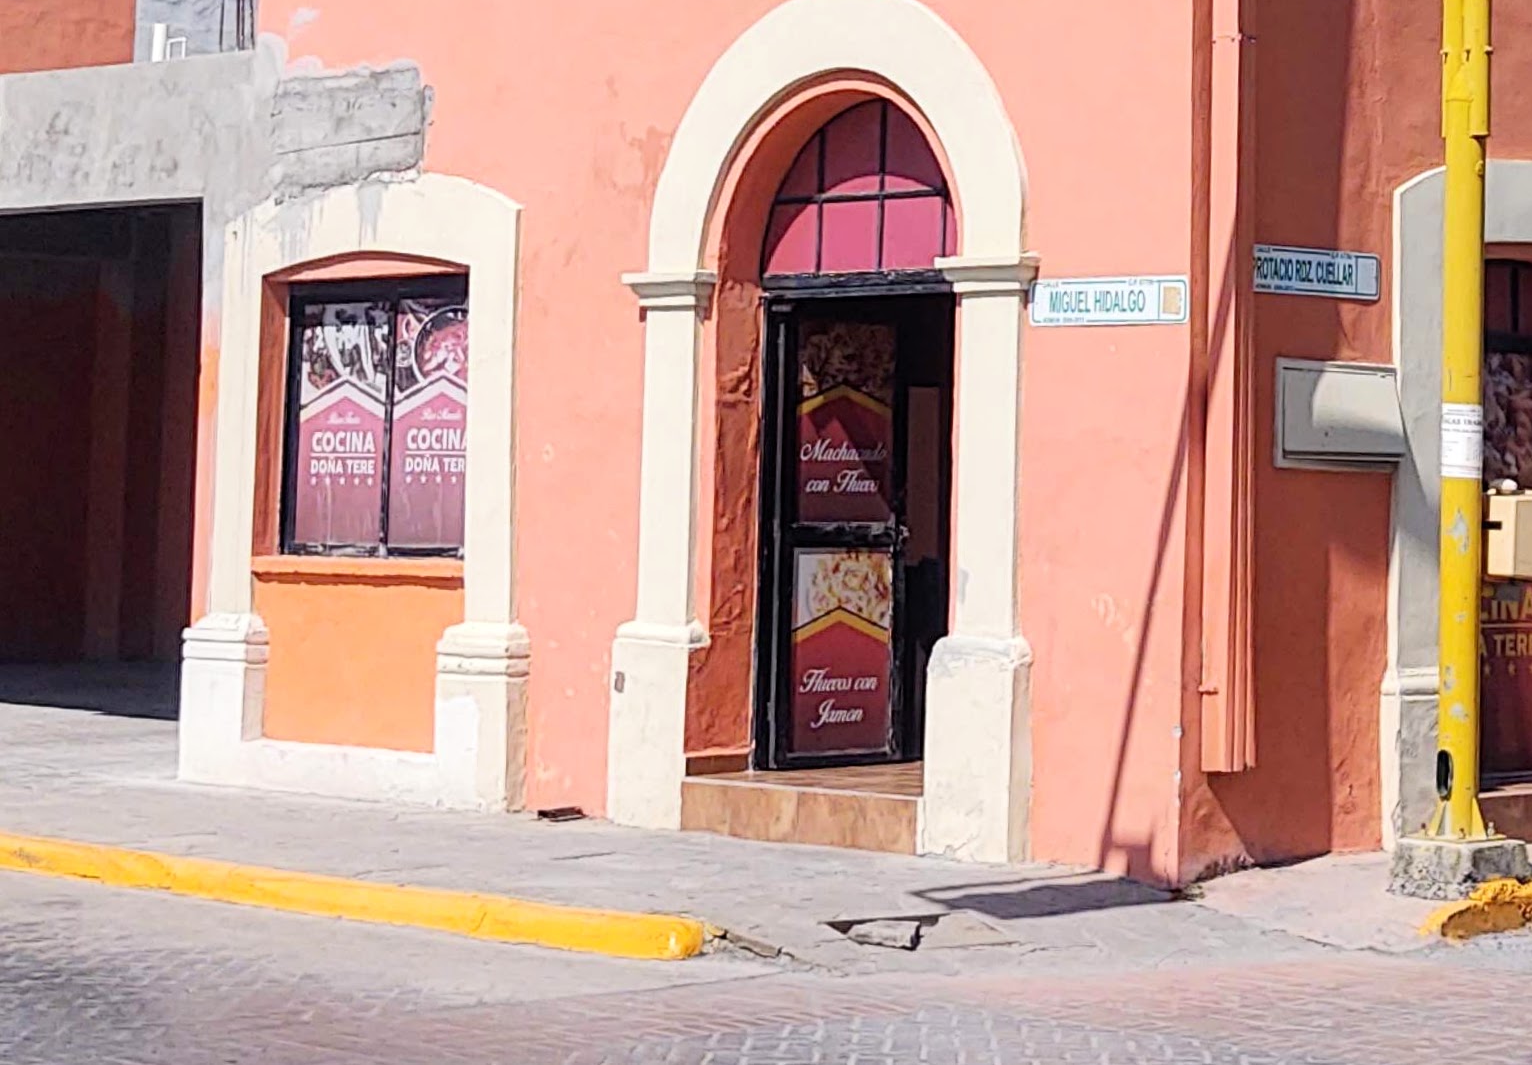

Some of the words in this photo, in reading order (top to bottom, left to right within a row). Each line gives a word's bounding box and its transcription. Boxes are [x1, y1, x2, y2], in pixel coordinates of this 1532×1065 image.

[1315, 261, 1353, 286] CUELLAR
[1049, 290, 1091, 313] MIGUEL
[1094, 289, 1146, 313] HIDALGO
[312, 431, 375, 453] COCINA
[310, 455, 343, 475] DOÑA
[345, 458, 375, 475] TERE
[405, 453, 440, 473] DOÑA
[805, 480, 830, 493] con
[853, 676, 879, 691] con
[810, 698, 864, 728] Jamon
